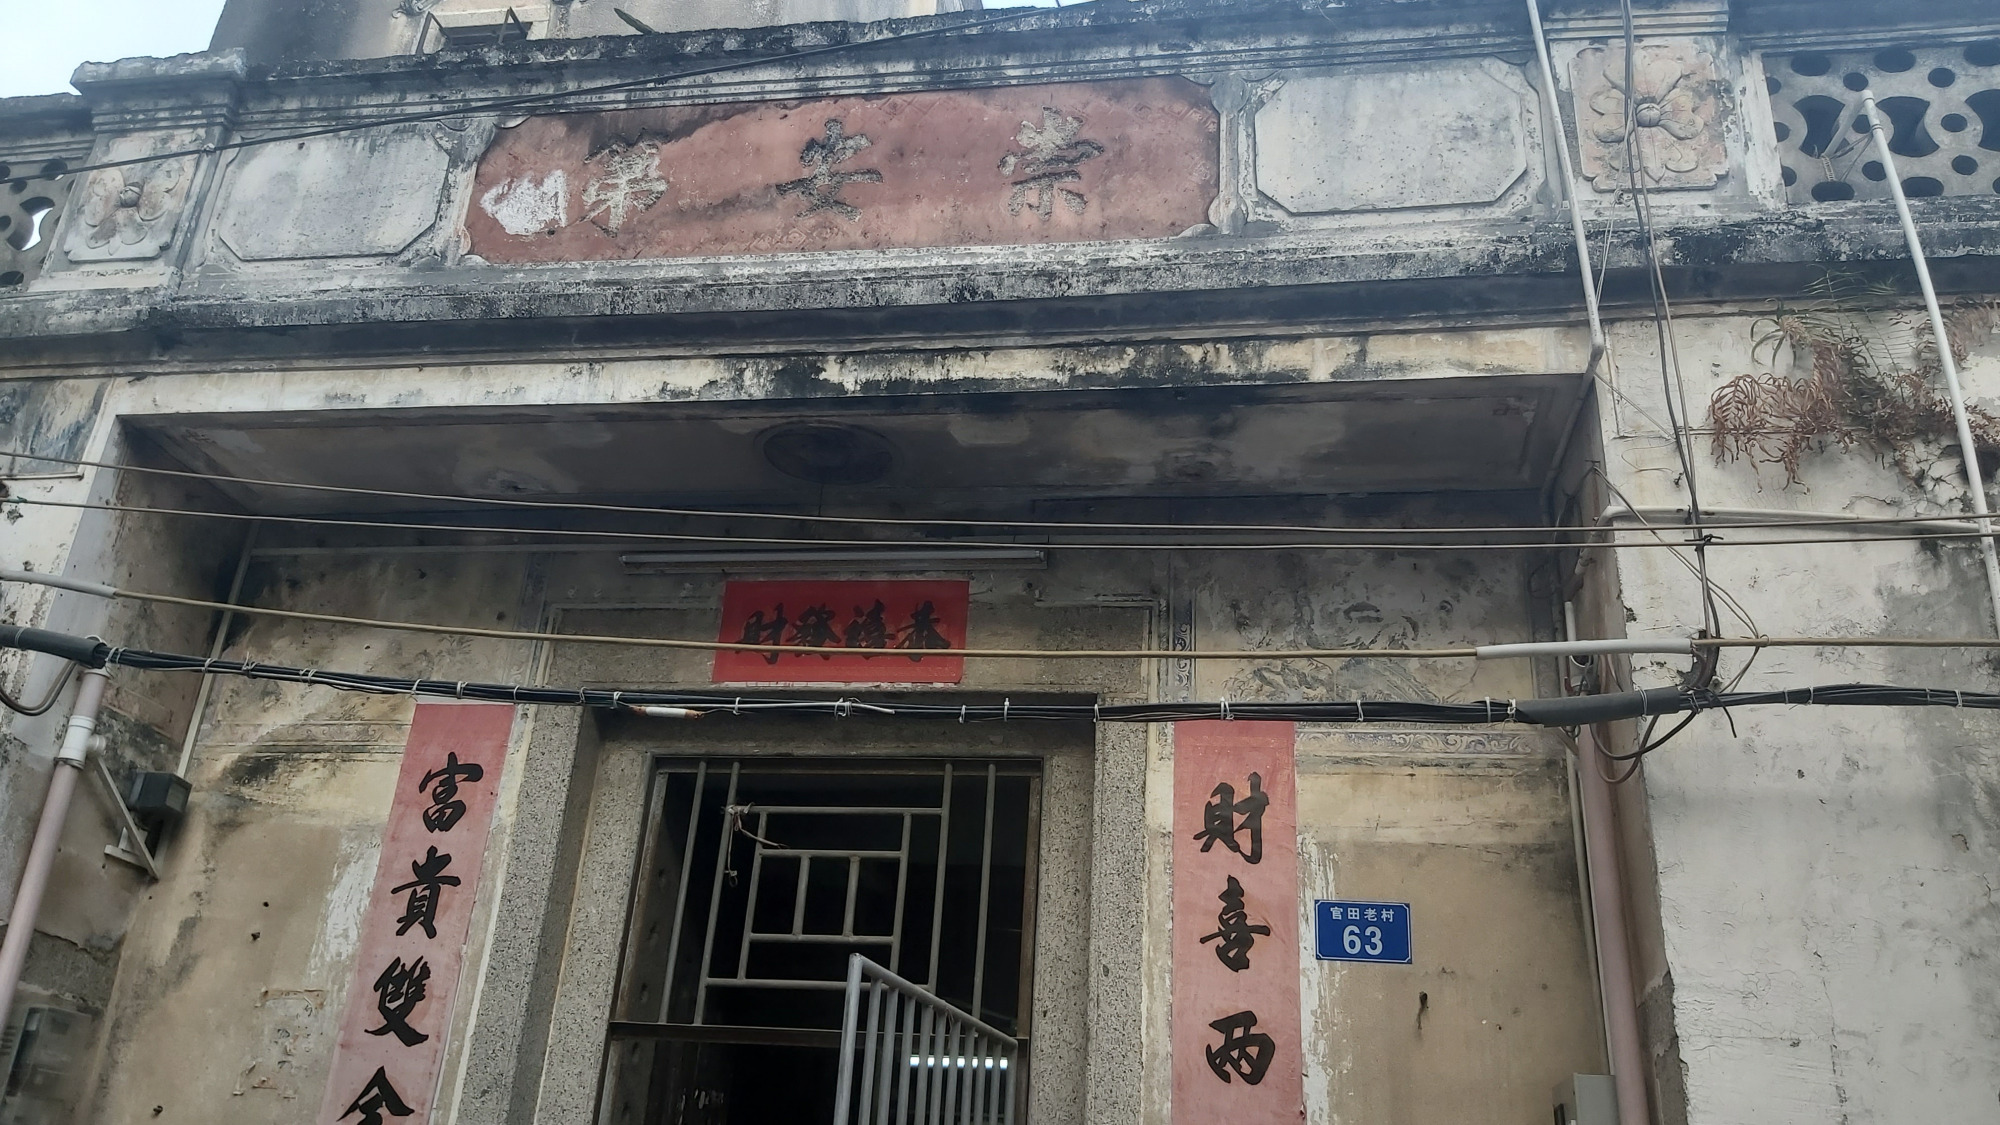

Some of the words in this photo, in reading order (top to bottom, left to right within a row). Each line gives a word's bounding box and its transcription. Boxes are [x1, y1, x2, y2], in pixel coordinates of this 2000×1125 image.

[1329, 905, 1395, 923] 官田老村
[1342, 924, 1384, 956] 63
